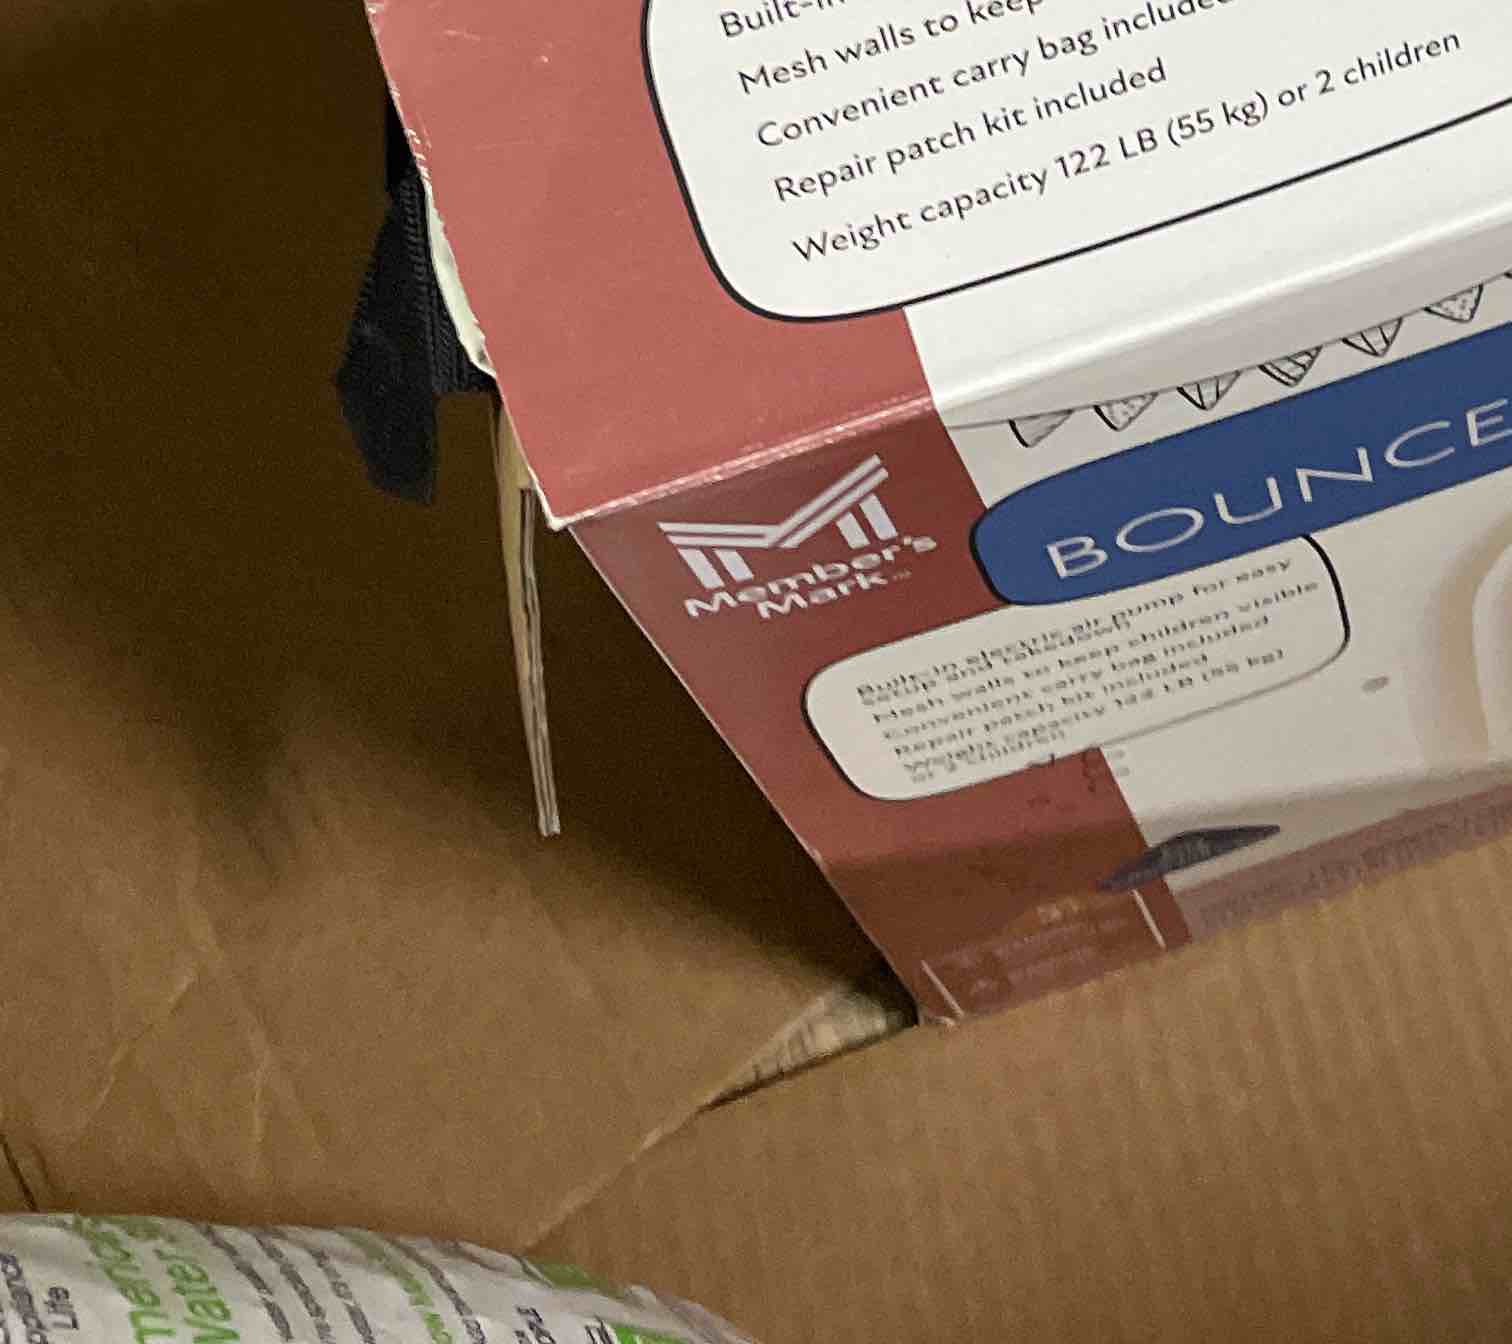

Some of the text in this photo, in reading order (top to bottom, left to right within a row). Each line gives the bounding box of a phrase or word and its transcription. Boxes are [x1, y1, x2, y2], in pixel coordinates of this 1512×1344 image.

[738, 49, 828, 95] Mesh
[834, 23, 917, 66] walls
[924, 11, 959, 38] to
[757, 75, 946, 149] Convenient
[951, 47, 1032, 90] carry
[1038, 24, 1100, 61] bag
[773, 56, 1169, 203] Repair patch kit included
[791, 29, 1462, 264] Weight capacity 122 LB (55 kg) or 2 children
[684, 534, 938, 618] Member's
